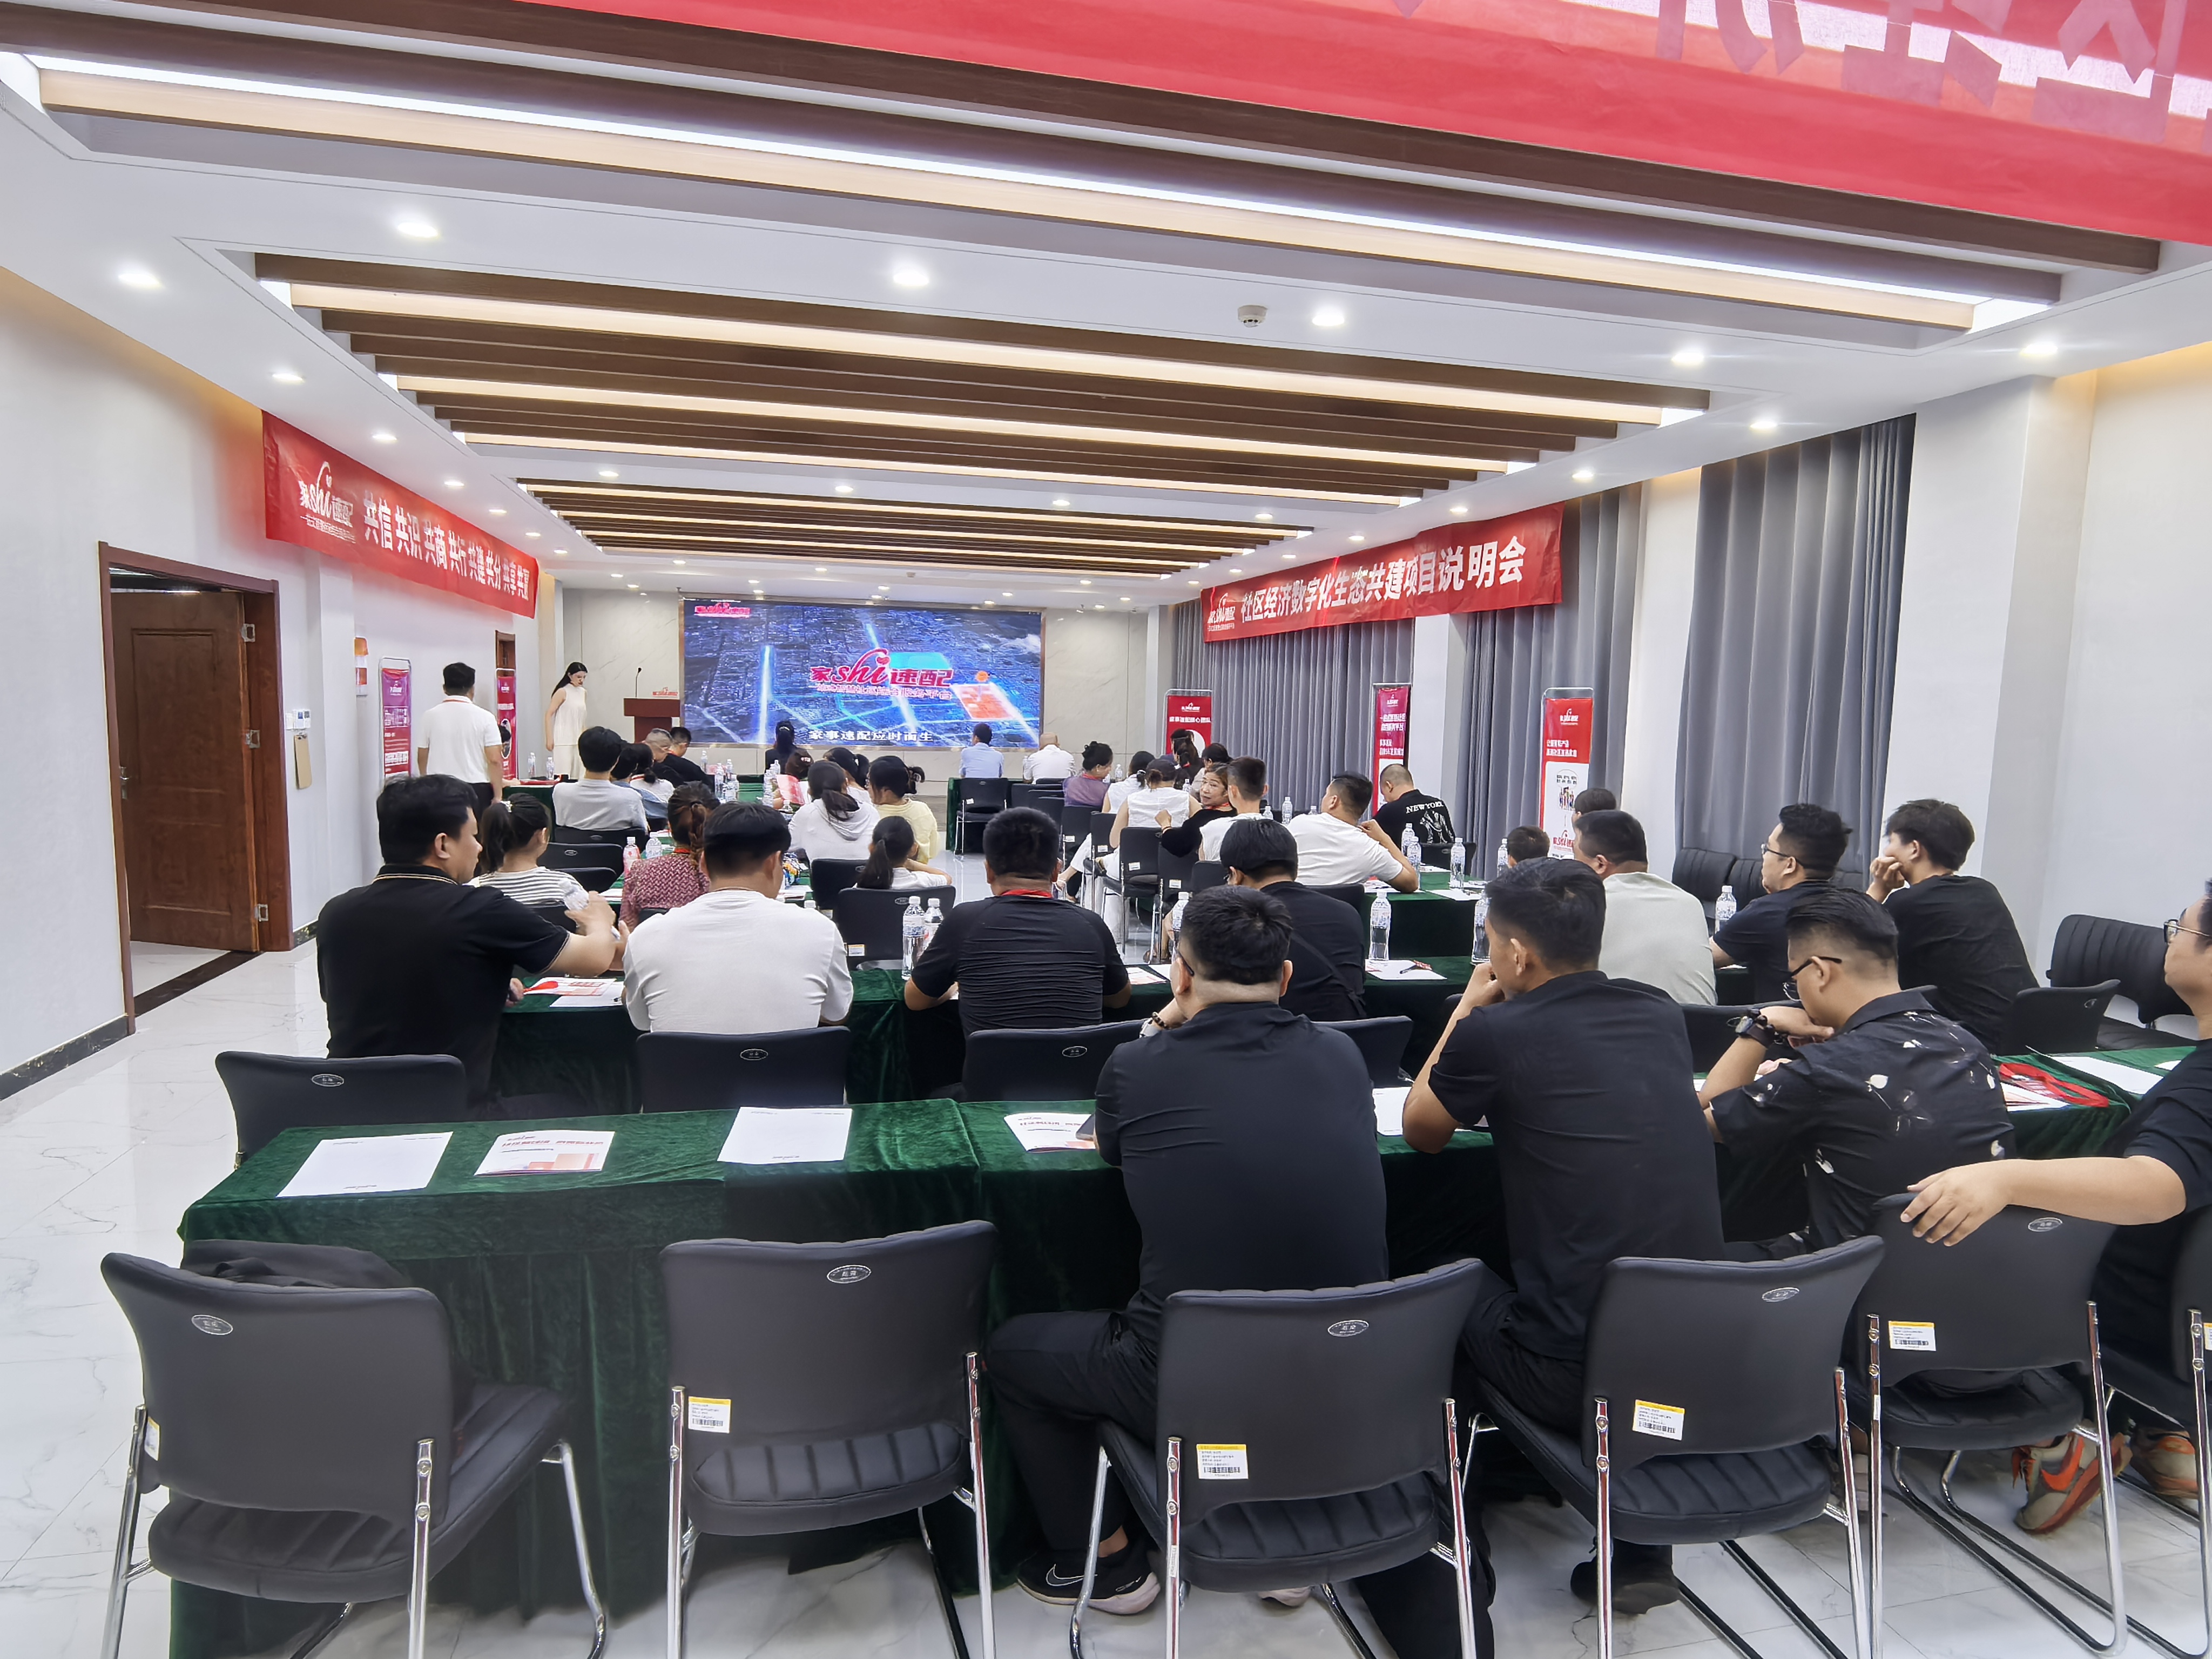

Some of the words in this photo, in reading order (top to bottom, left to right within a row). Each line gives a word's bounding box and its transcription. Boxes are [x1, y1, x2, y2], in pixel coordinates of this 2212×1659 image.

[363, 489, 393, 551] 共信
[1240, 535, 1527, 623] 社区经济数字化生态共建项目说明会
[810, 648, 954, 688] 家shi速配
[808, 730, 934, 742] 家事速配应时而生
[1406, 804, 1425, 814] NEW
